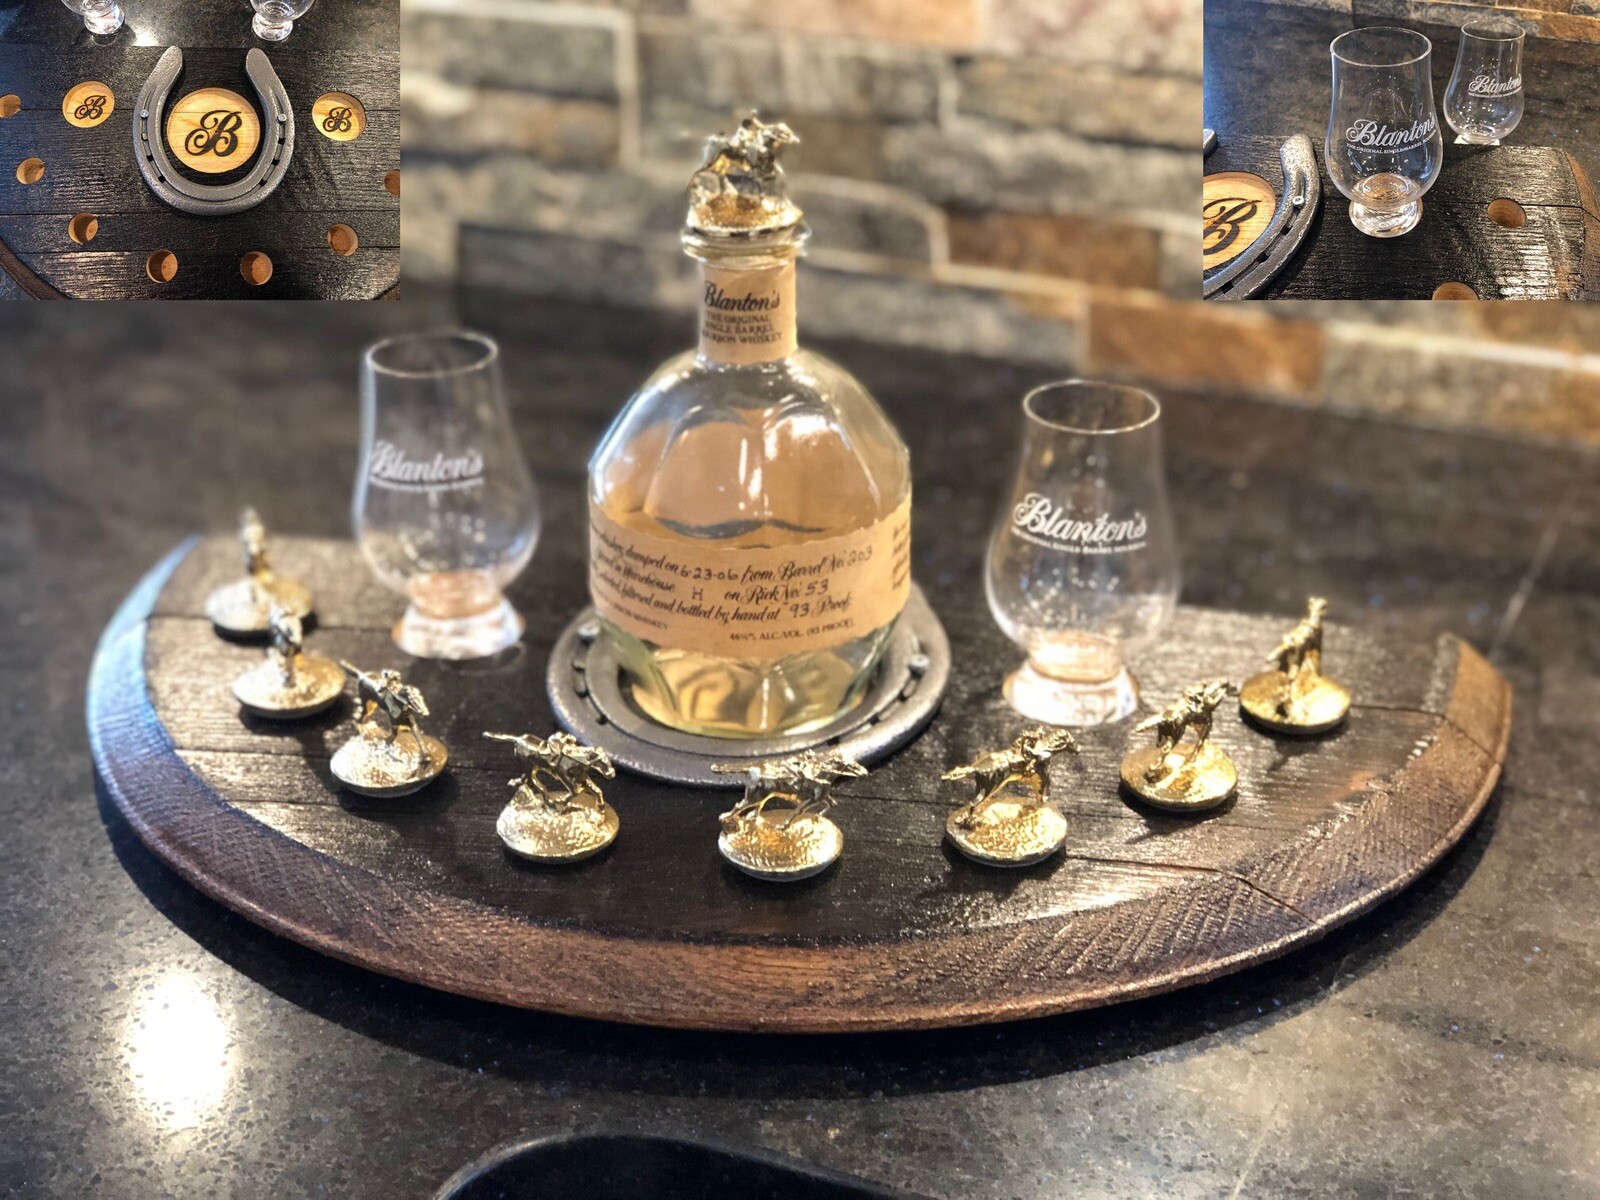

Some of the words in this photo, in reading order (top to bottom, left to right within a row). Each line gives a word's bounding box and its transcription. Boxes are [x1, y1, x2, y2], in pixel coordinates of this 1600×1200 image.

[74, 95, 107, 120] B
[322, 107, 352, 132] B
[185, 109, 243, 157] B
[1345, 112, 1437, 146] Blanton's
[704, 280, 780, 311] Blanton's
[1013, 492, 1147, 543] Blanton's
[740, 564, 774, 586] from
[691, 586, 704, 601] H
[804, 578, 829, 596] 53
[789, 602, 810, 618] 93
